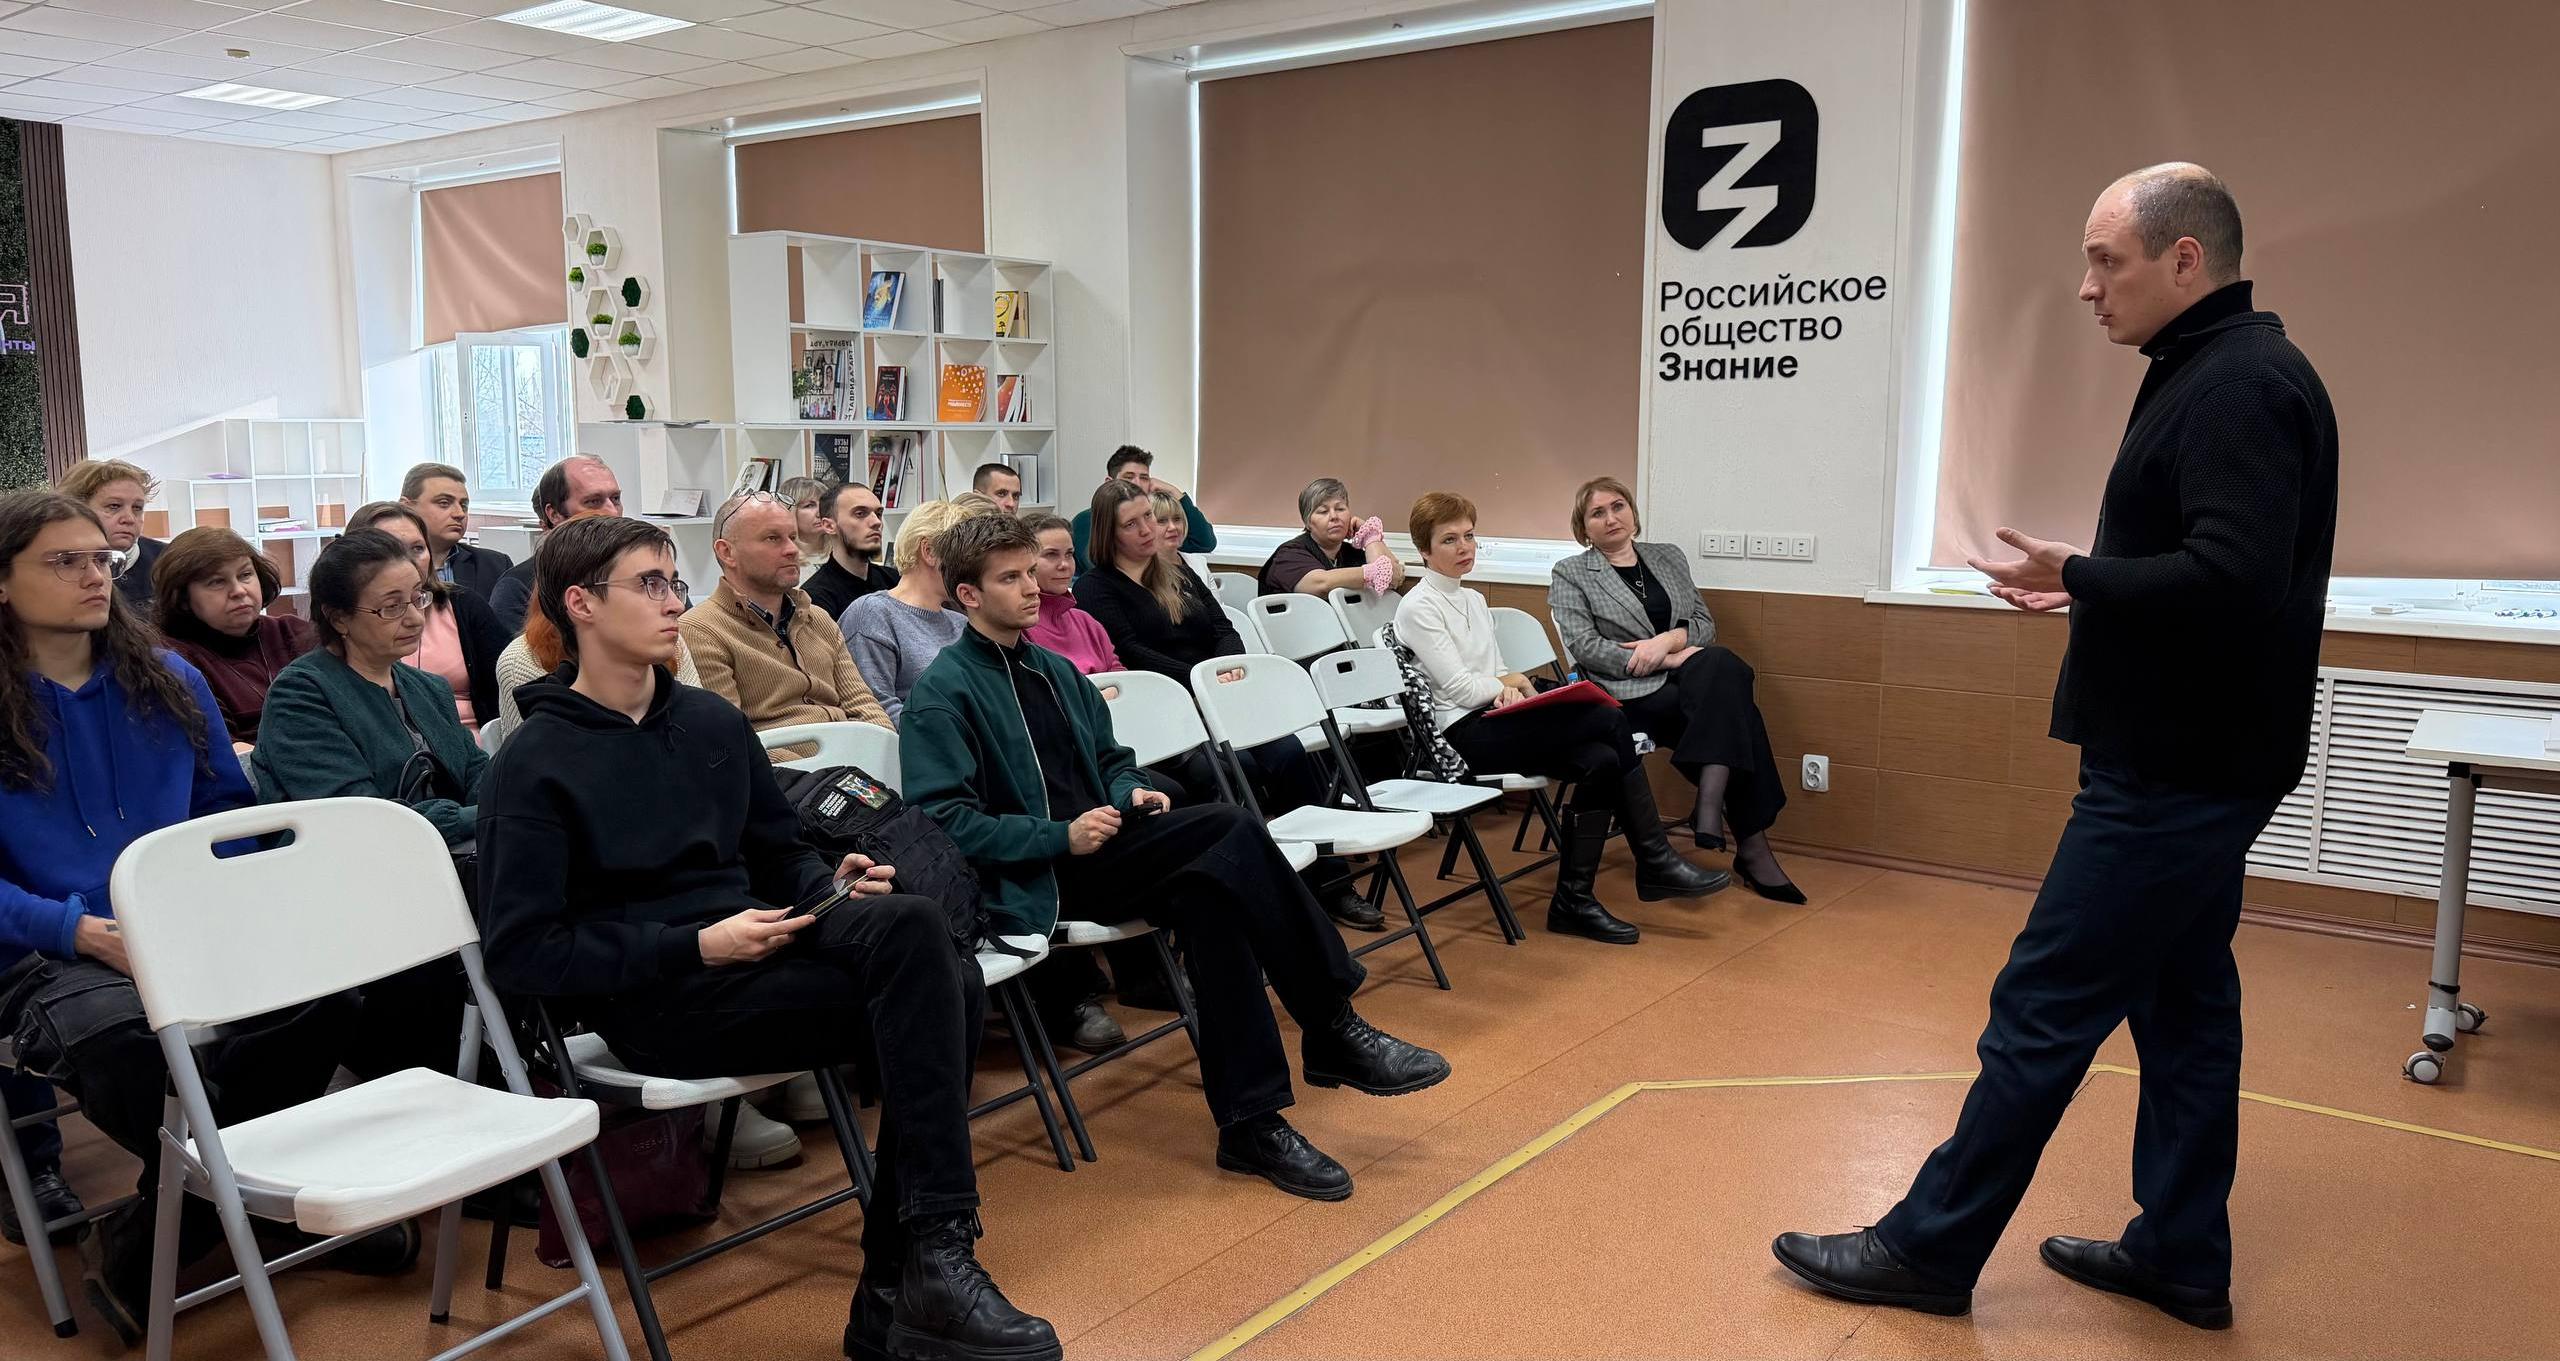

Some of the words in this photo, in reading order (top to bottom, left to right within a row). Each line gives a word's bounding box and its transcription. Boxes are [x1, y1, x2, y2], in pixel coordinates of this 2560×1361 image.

[1660, 274, 1887, 312] Российское
[1659, 315, 1843, 349] общество
[1659, 352, 1799, 382] Знание
